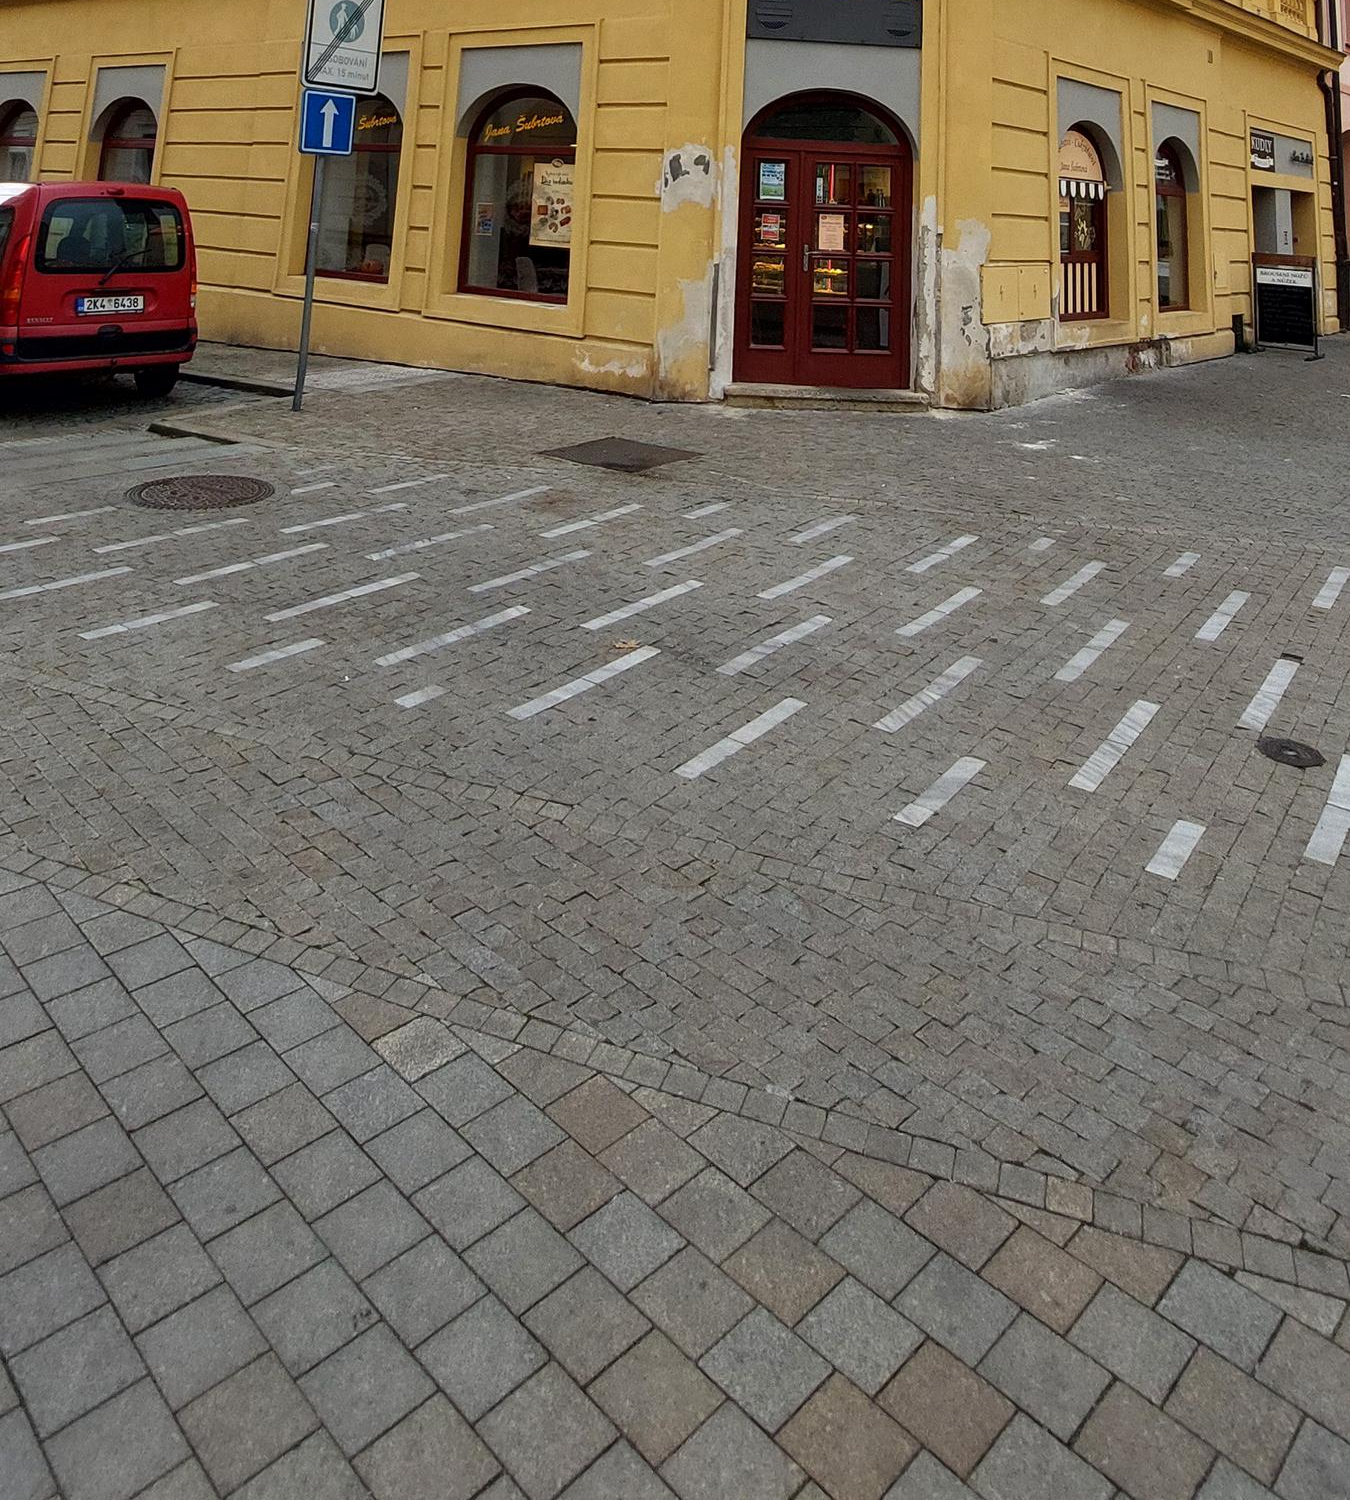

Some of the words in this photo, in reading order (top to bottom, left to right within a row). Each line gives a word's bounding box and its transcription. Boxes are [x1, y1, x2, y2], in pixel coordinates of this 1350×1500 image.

[484, 123, 512, 142] Jana
[86, 299, 106, 311] 2K4
[113, 297, 139, 309] 6438
